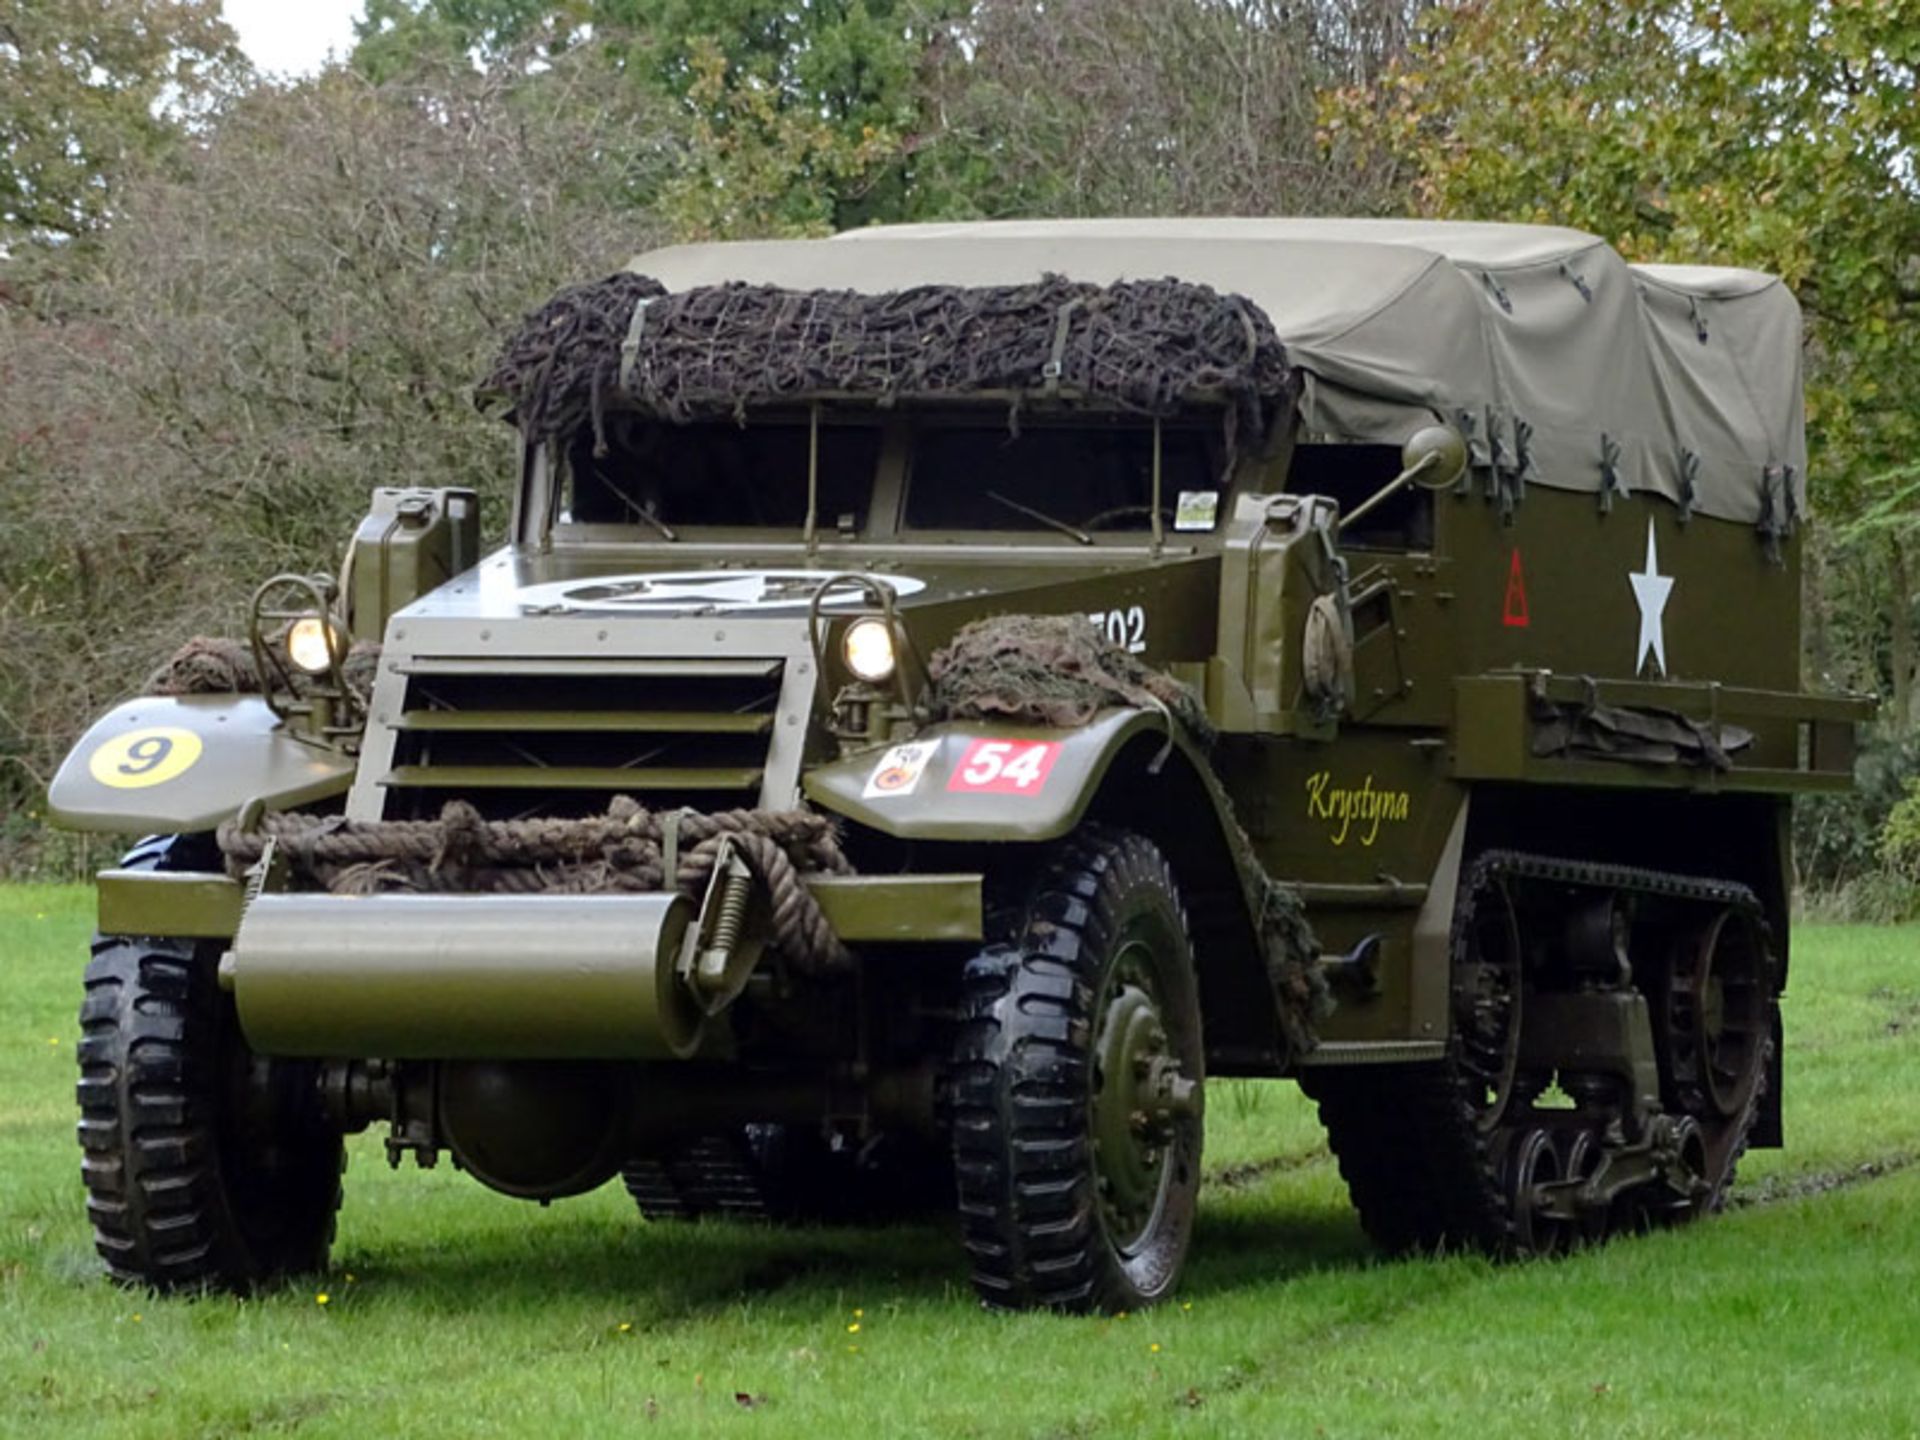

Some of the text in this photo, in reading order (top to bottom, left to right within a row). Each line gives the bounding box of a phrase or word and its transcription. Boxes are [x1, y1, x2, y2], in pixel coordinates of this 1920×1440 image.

[1089, 605, 1146, 653] 02
[117, 736, 173, 775] 9
[963, 742, 1048, 788] 54
[1305, 771, 1410, 846] Krystyna
